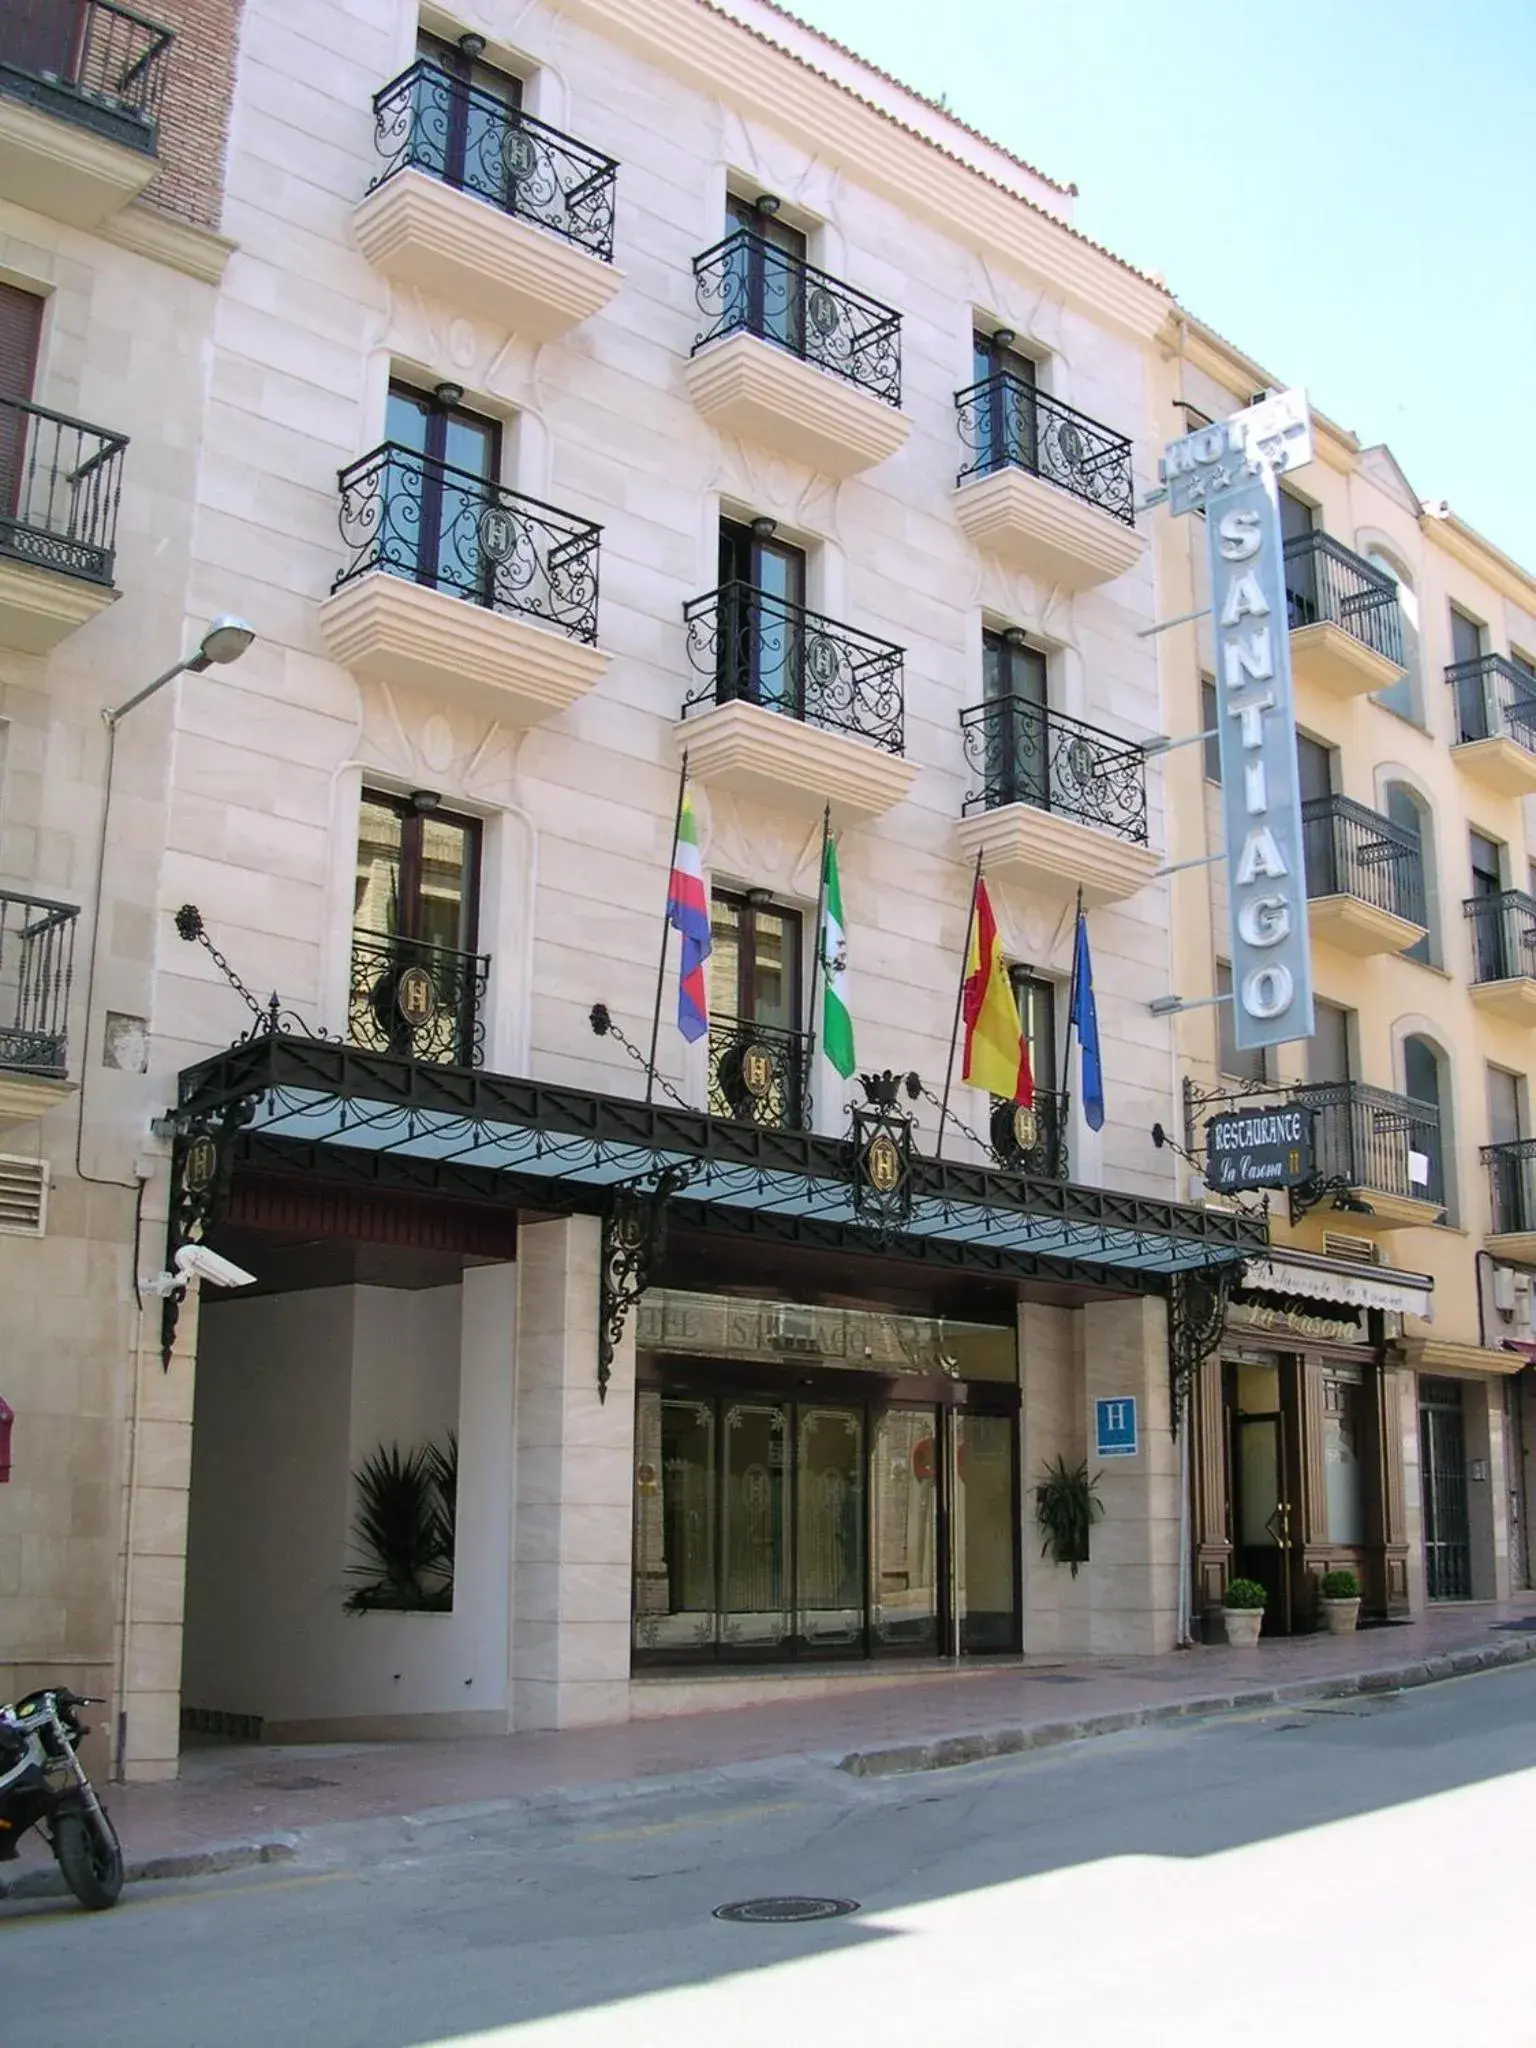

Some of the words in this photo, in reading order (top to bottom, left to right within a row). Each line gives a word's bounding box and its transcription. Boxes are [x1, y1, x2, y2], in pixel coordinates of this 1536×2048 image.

[1217, 509, 1294, 1020] SANTIAGO
[1215, 1112, 1301, 1150] RESTAURANTE
[1220, 1157, 1236, 1183] La
[1239, 1155, 1283, 1180] Casona
[1247, 1294, 1276, 1331] La
[1283, 1298, 1358, 1342] Casona
[1107, 1403, 1126, 1430] H
